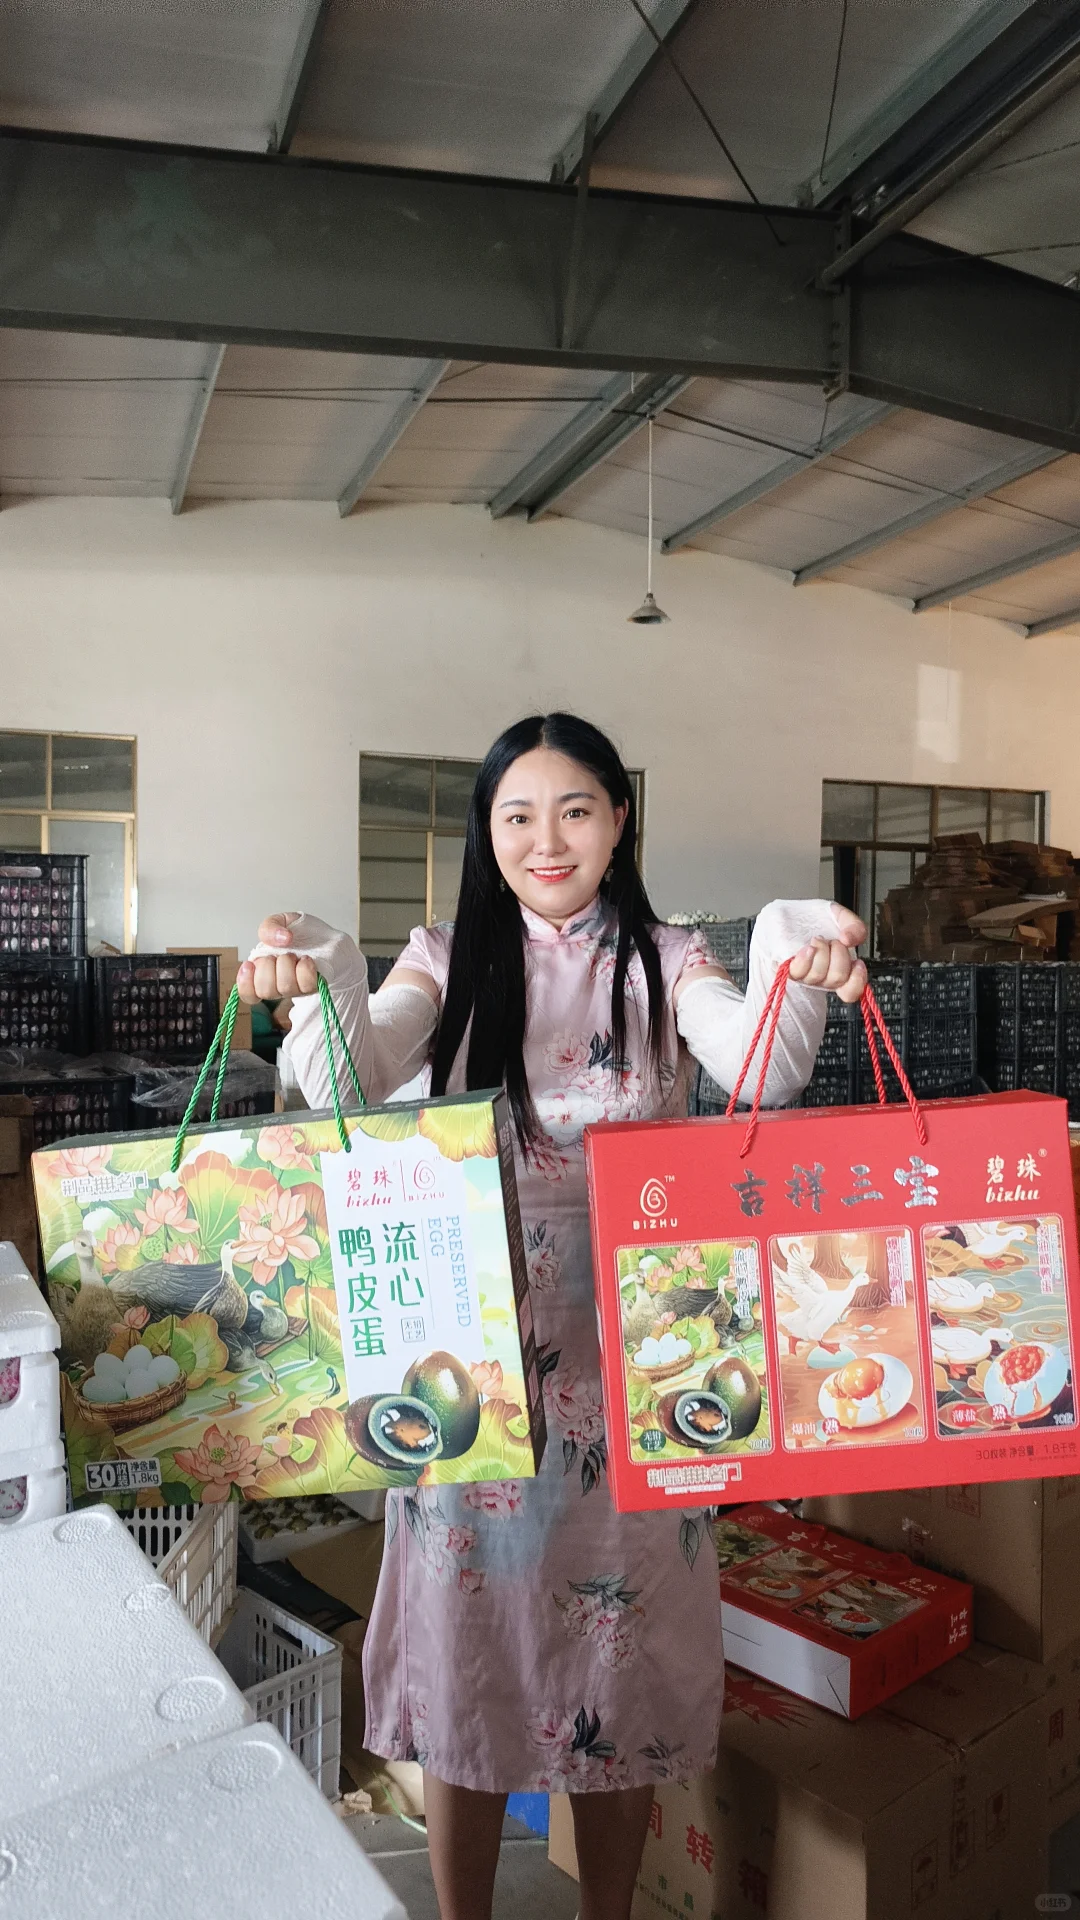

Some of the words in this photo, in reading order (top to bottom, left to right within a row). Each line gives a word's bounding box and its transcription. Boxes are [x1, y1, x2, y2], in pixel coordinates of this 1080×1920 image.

[347, 1165, 393, 1192] 碧珠
[986, 1153, 1041, 1185] 碧珠
[730, 1155, 939, 1217] 吉祥三宝
[427, 1217, 445, 1258] EGG
[632, 1218, 678, 1230] BIZHU
[382, 1221, 424, 1307] 流心
[447, 1215, 472, 1328] PRESERVED
[338, 1226, 387, 1358] 鸭皮蛋
[130, 1460, 157, 1471] 净含量
[1010, 1445, 1035, 1458] 净含量
[131, 1472, 159, 1484] 1.8kg
